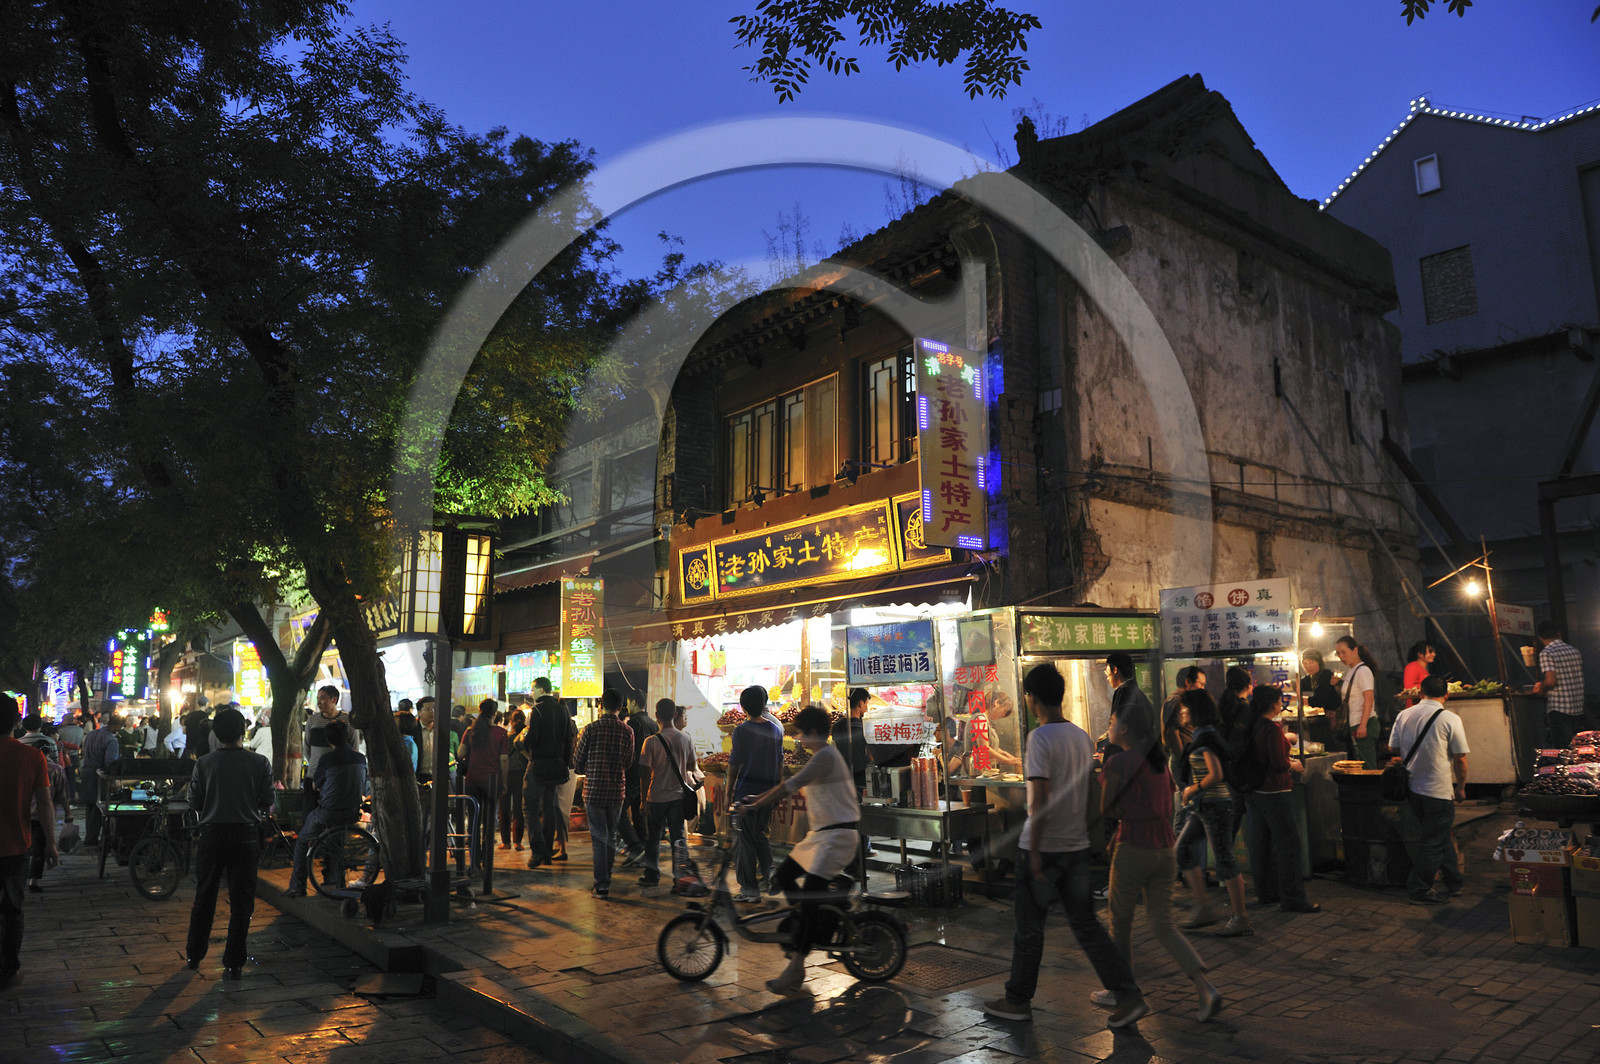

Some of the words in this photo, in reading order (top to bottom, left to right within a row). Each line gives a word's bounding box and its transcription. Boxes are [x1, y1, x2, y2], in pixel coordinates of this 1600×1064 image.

[925, 356, 941, 376] 清
[937, 352, 964, 369] 老字号
[936, 373, 971, 532] 老孙家土特产
[724, 525, 880, 578] 老孙家土特产
[1174, 596, 1189, 607] 清
[1256, 588, 1272, 601] 真
[569, 591, 597, 683] 老孙家绿豆糕
[872, 631, 904, 643] 老孙家
[1037, 622, 1156, 645] 老孙家腊牛羊肉
[1170, 616, 1184, 652] 韭黄馅饼
[1189, 615, 1204, 652] 韭菜馅饼
[1206, 613, 1221, 650] 茴香馅饼
[1225, 612, 1240, 649] 酸菜馅饼
[1245, 610, 1260, 648] 麻辣串
[1265, 608, 1282, 647] 涮牛肚
[852, 651, 930, 676] 冰镇酸梅汤
[954, 664, 1000, 684] 老孙家
[873, 722, 924, 742] 酸梅汤
[968, 689, 992, 771] 肉夹馍
